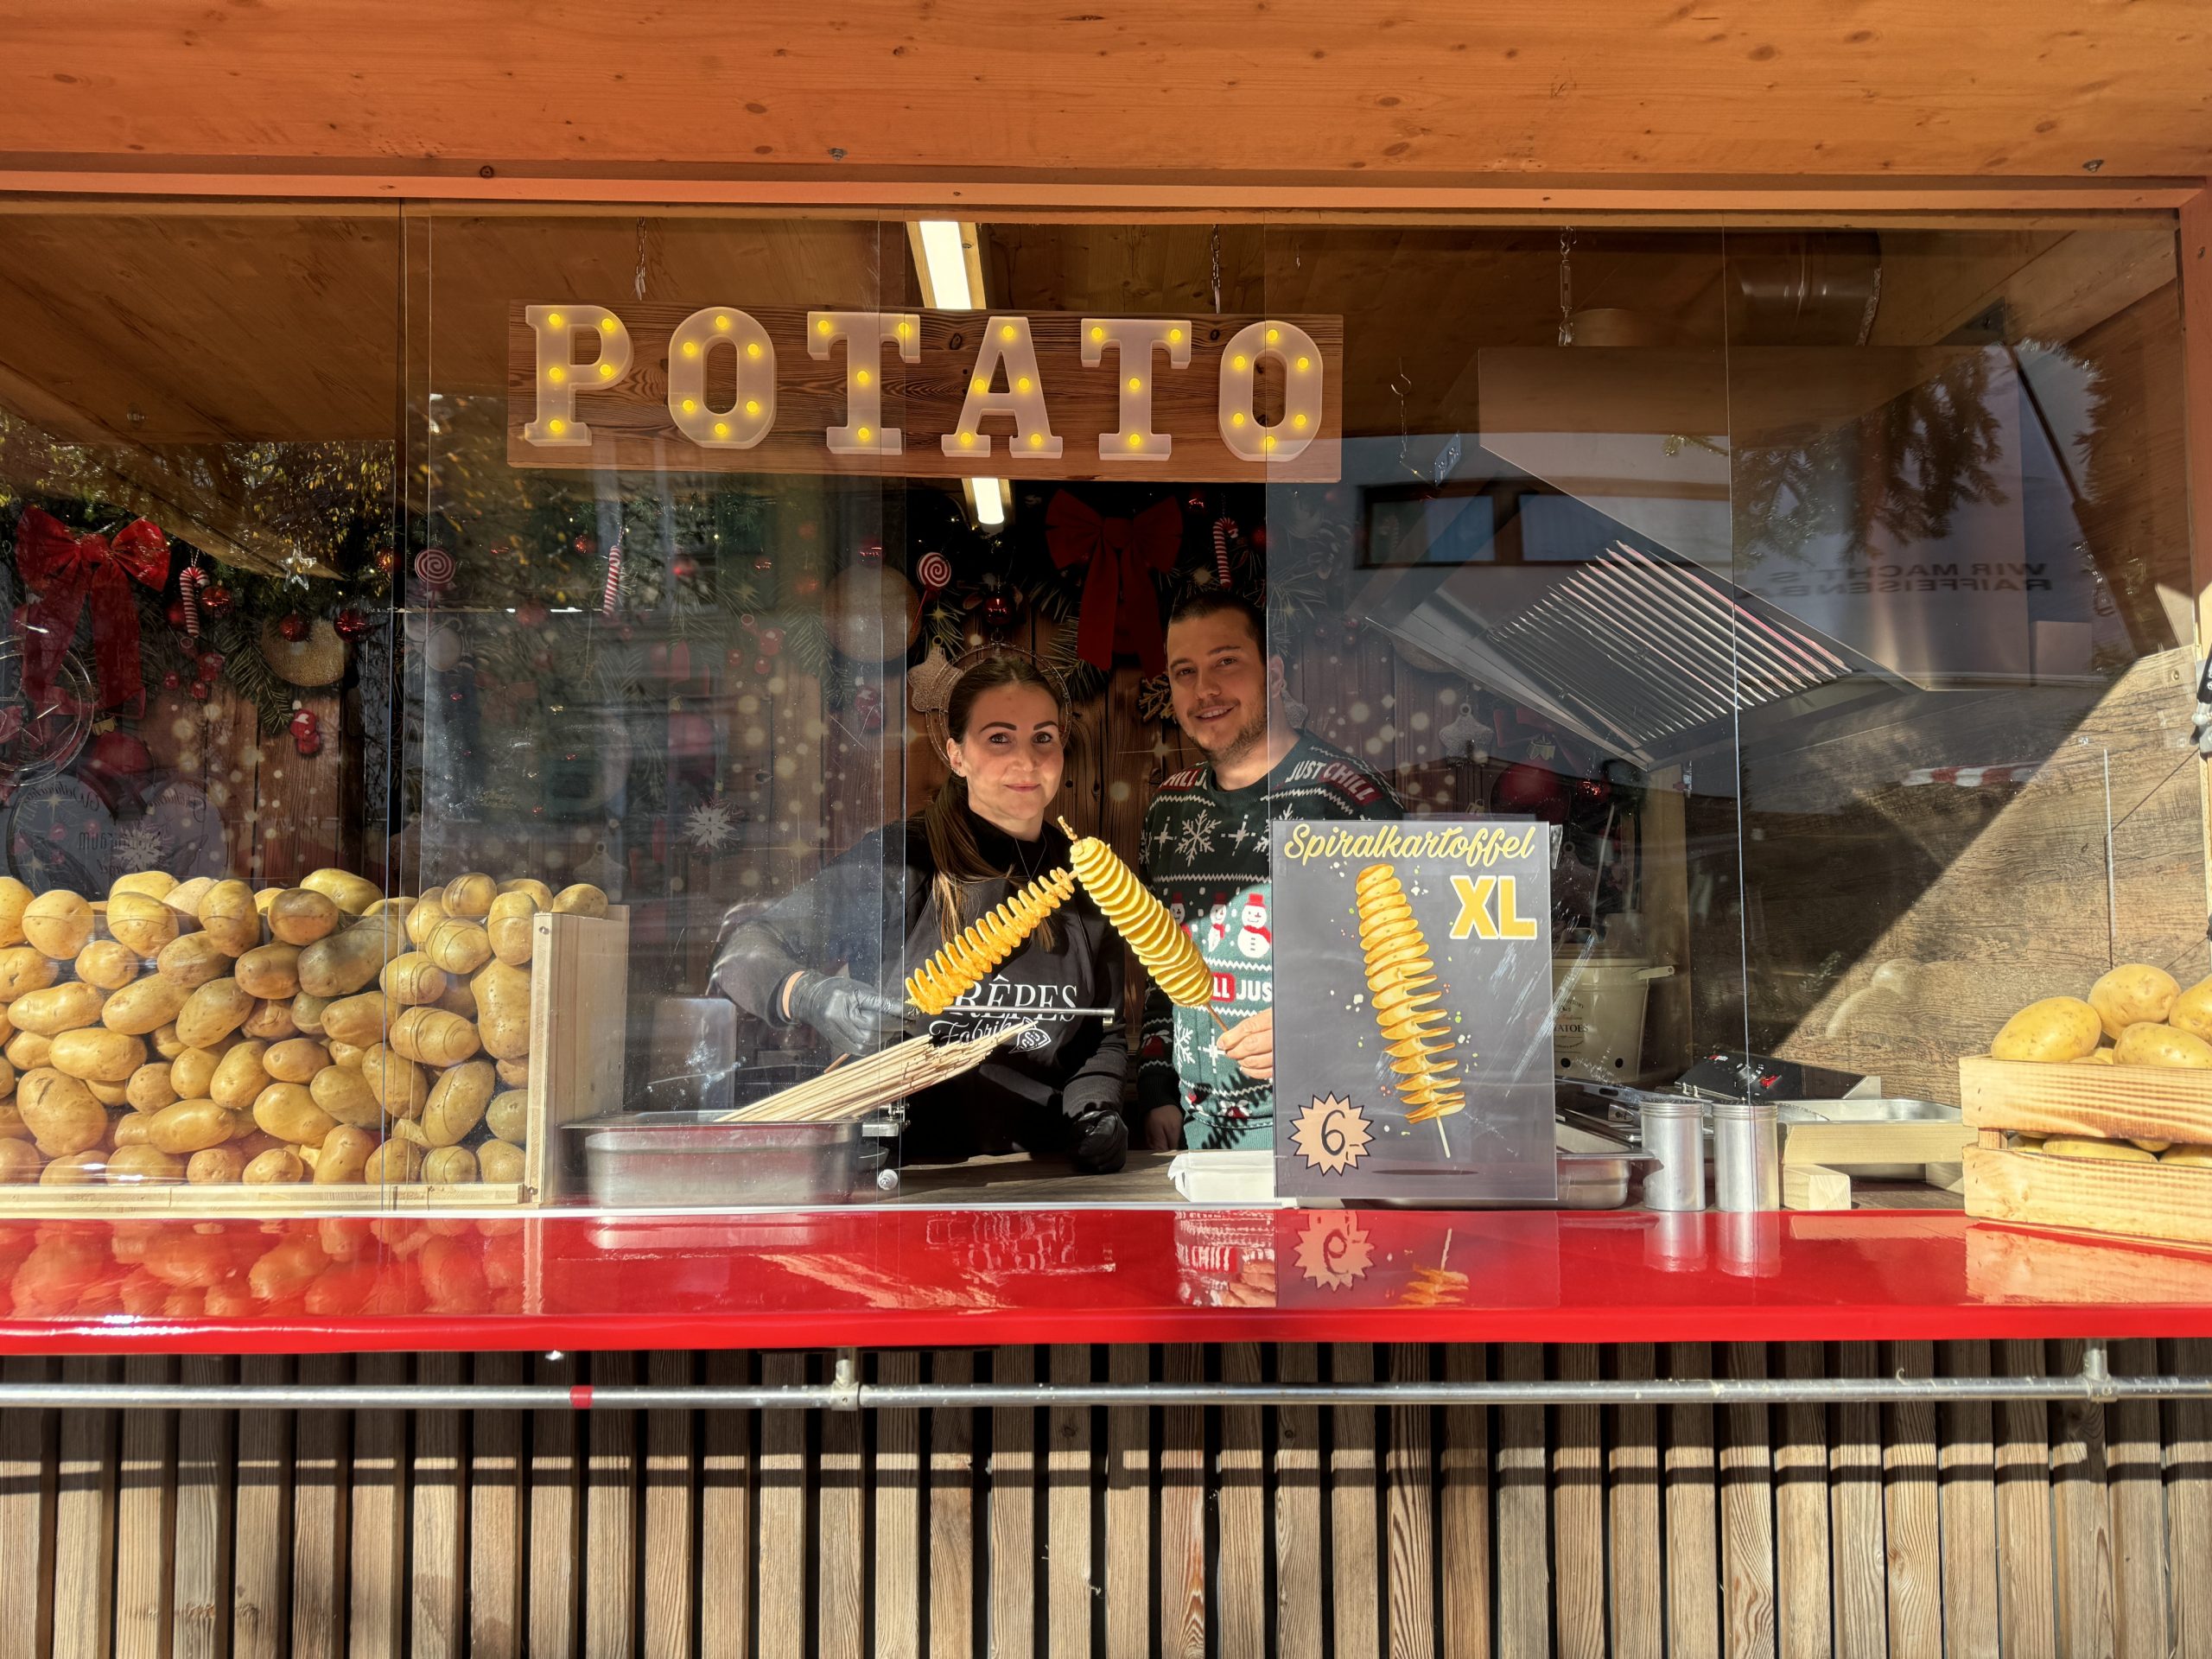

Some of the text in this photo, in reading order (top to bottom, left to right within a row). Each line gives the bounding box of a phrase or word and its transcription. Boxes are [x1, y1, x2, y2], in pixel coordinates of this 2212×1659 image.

[524, 304, 1324, 462] POTATO
[1285, 760, 1375, 801] JUST CHILL
[1284, 823, 1536, 868] Spiralkartoffel
[1449, 874, 1538, 940] XL
